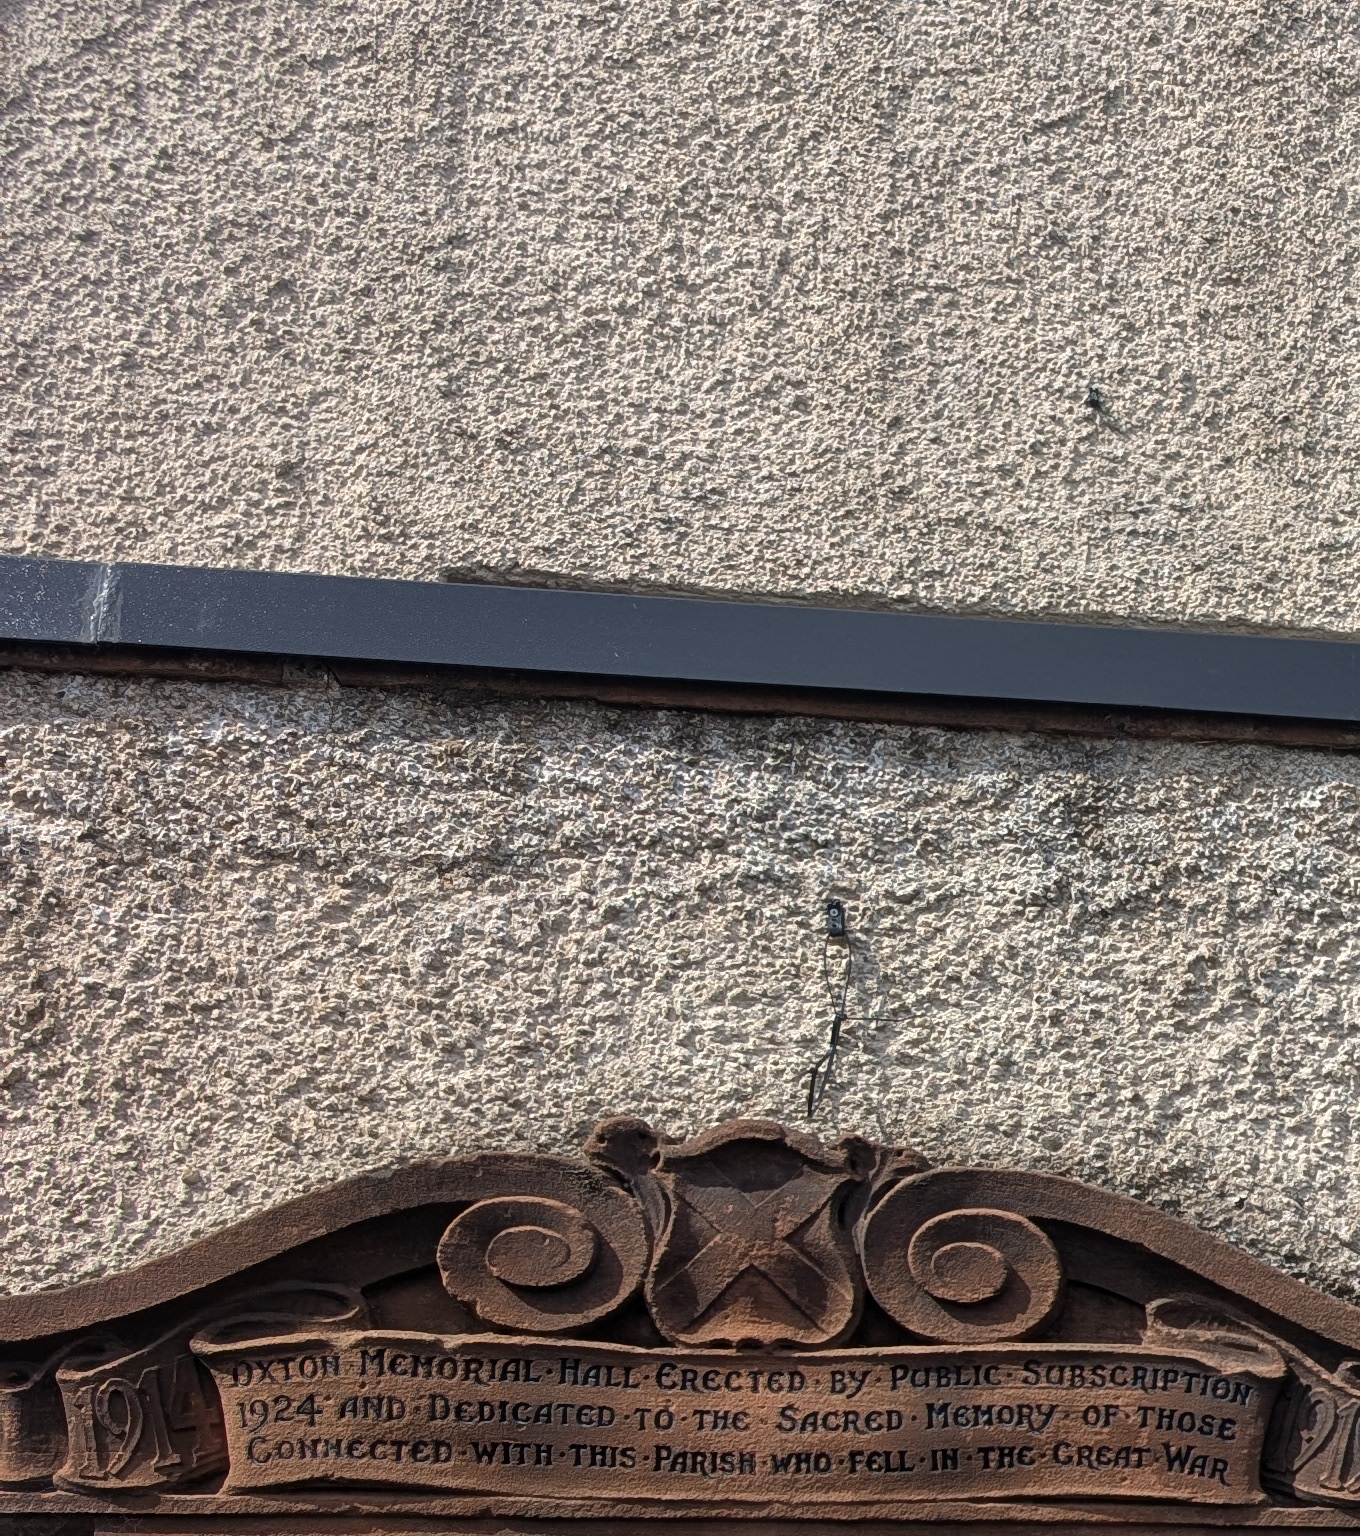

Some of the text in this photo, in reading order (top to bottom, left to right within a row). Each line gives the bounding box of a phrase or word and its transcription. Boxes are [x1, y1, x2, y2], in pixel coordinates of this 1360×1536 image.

[559, 1357, 641, 1390] HALL
[655, 1363, 806, 1394] ERECTED
[830, 1368, 871, 1399] BY
[891, 1363, 1001, 1391] PUBLIC
[74, 1353, 220, 1480] 1914
[237, 1392, 1237, 1440] 1924 AND DEDICATED TO THE SACRED MEMORY OF THOSE
[470, 1440, 553, 1465] WITH
[569, 1442, 637, 1469] THIS
[654, 1445, 757, 1477] PARISH
[771, 1451, 833, 1473] WHO
[849, 1449, 916, 1473] FELL
[930, 1447, 959, 1471] IN
[977, 1445, 1037, 1469] THE
[1051, 1441, 1150, 1469] GREAT
[1165, 1442, 1232, 1486] WAR
